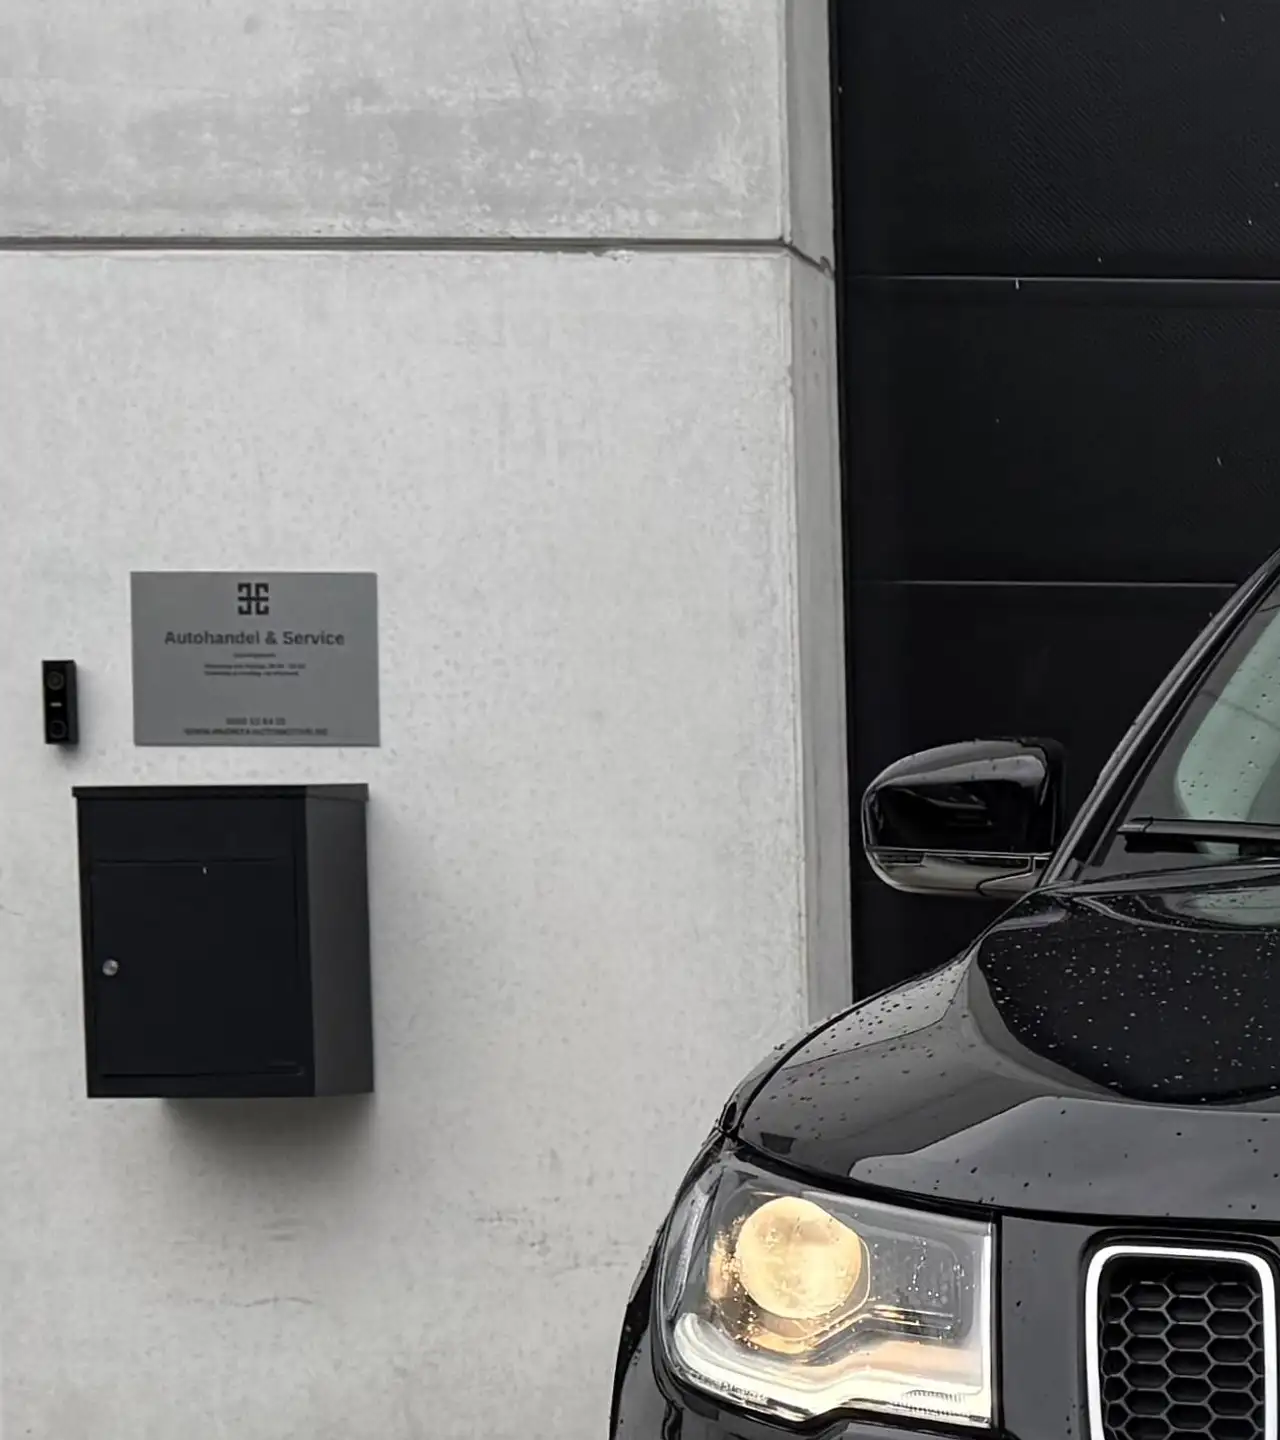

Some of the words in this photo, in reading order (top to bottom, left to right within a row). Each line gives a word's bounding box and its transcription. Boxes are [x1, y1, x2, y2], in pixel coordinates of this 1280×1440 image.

[164, 630, 260, 645] Autohandel
[265, 631, 278, 645] &
[283, 630, 345, 646] Service
